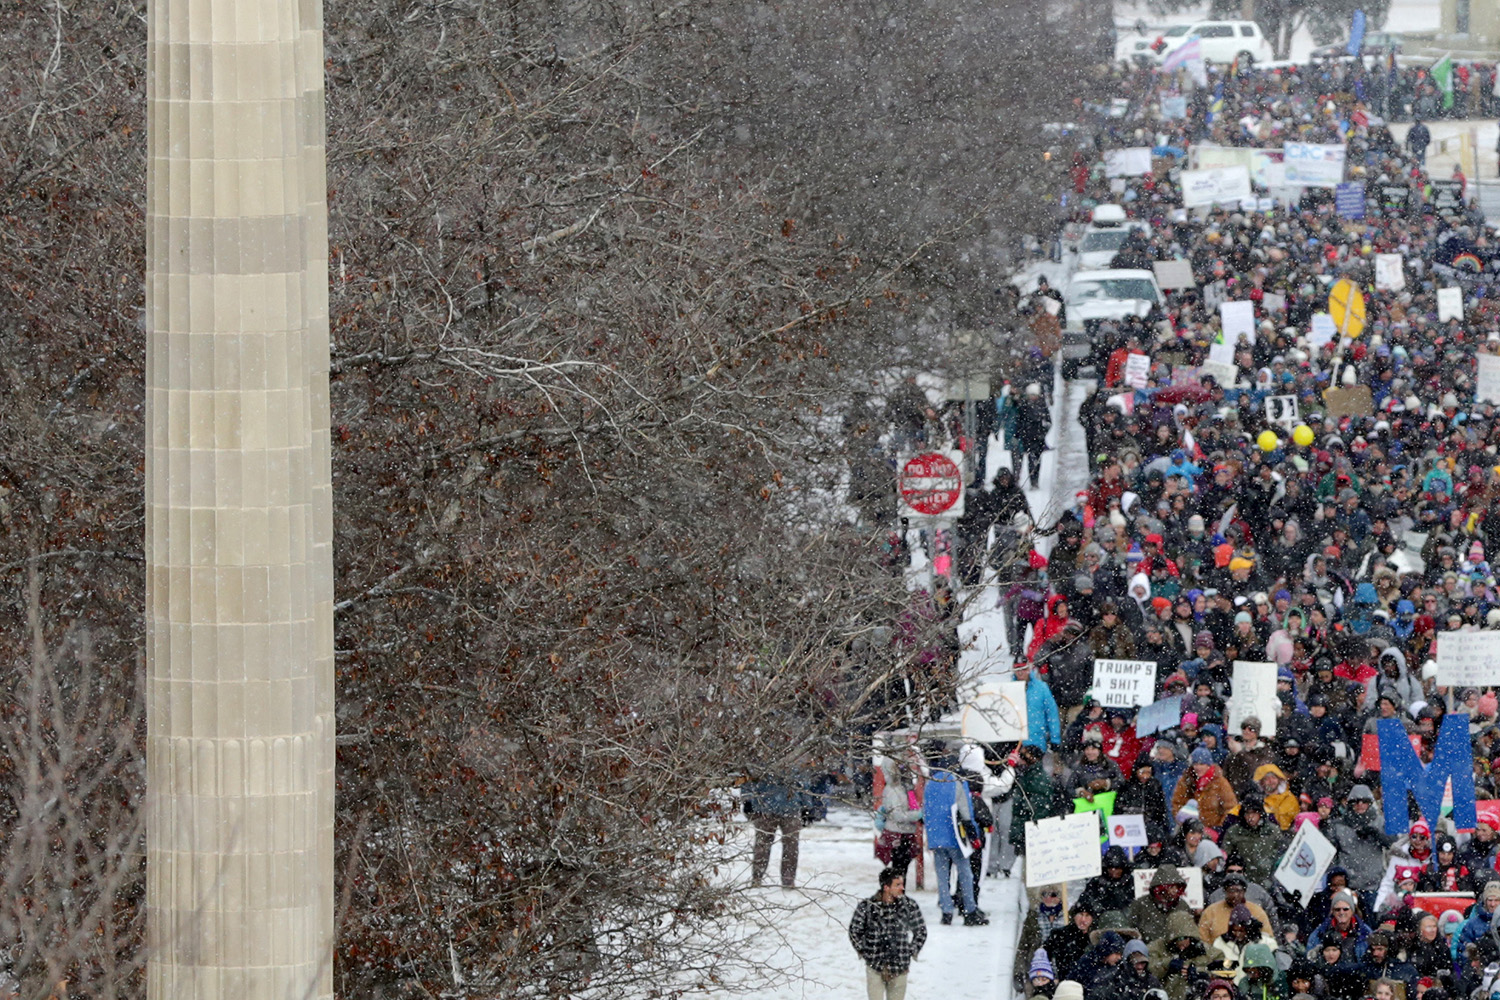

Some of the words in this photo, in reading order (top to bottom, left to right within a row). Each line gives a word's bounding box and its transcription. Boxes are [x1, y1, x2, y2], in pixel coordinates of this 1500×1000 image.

[908, 464, 924, 475] DO
[1098, 662, 1153, 676] TRUMP'S
[1095, 679, 1101, 688] A
[1110, 679, 1139, 691] SHIT
[1106, 693, 1139, 705] HOLE
